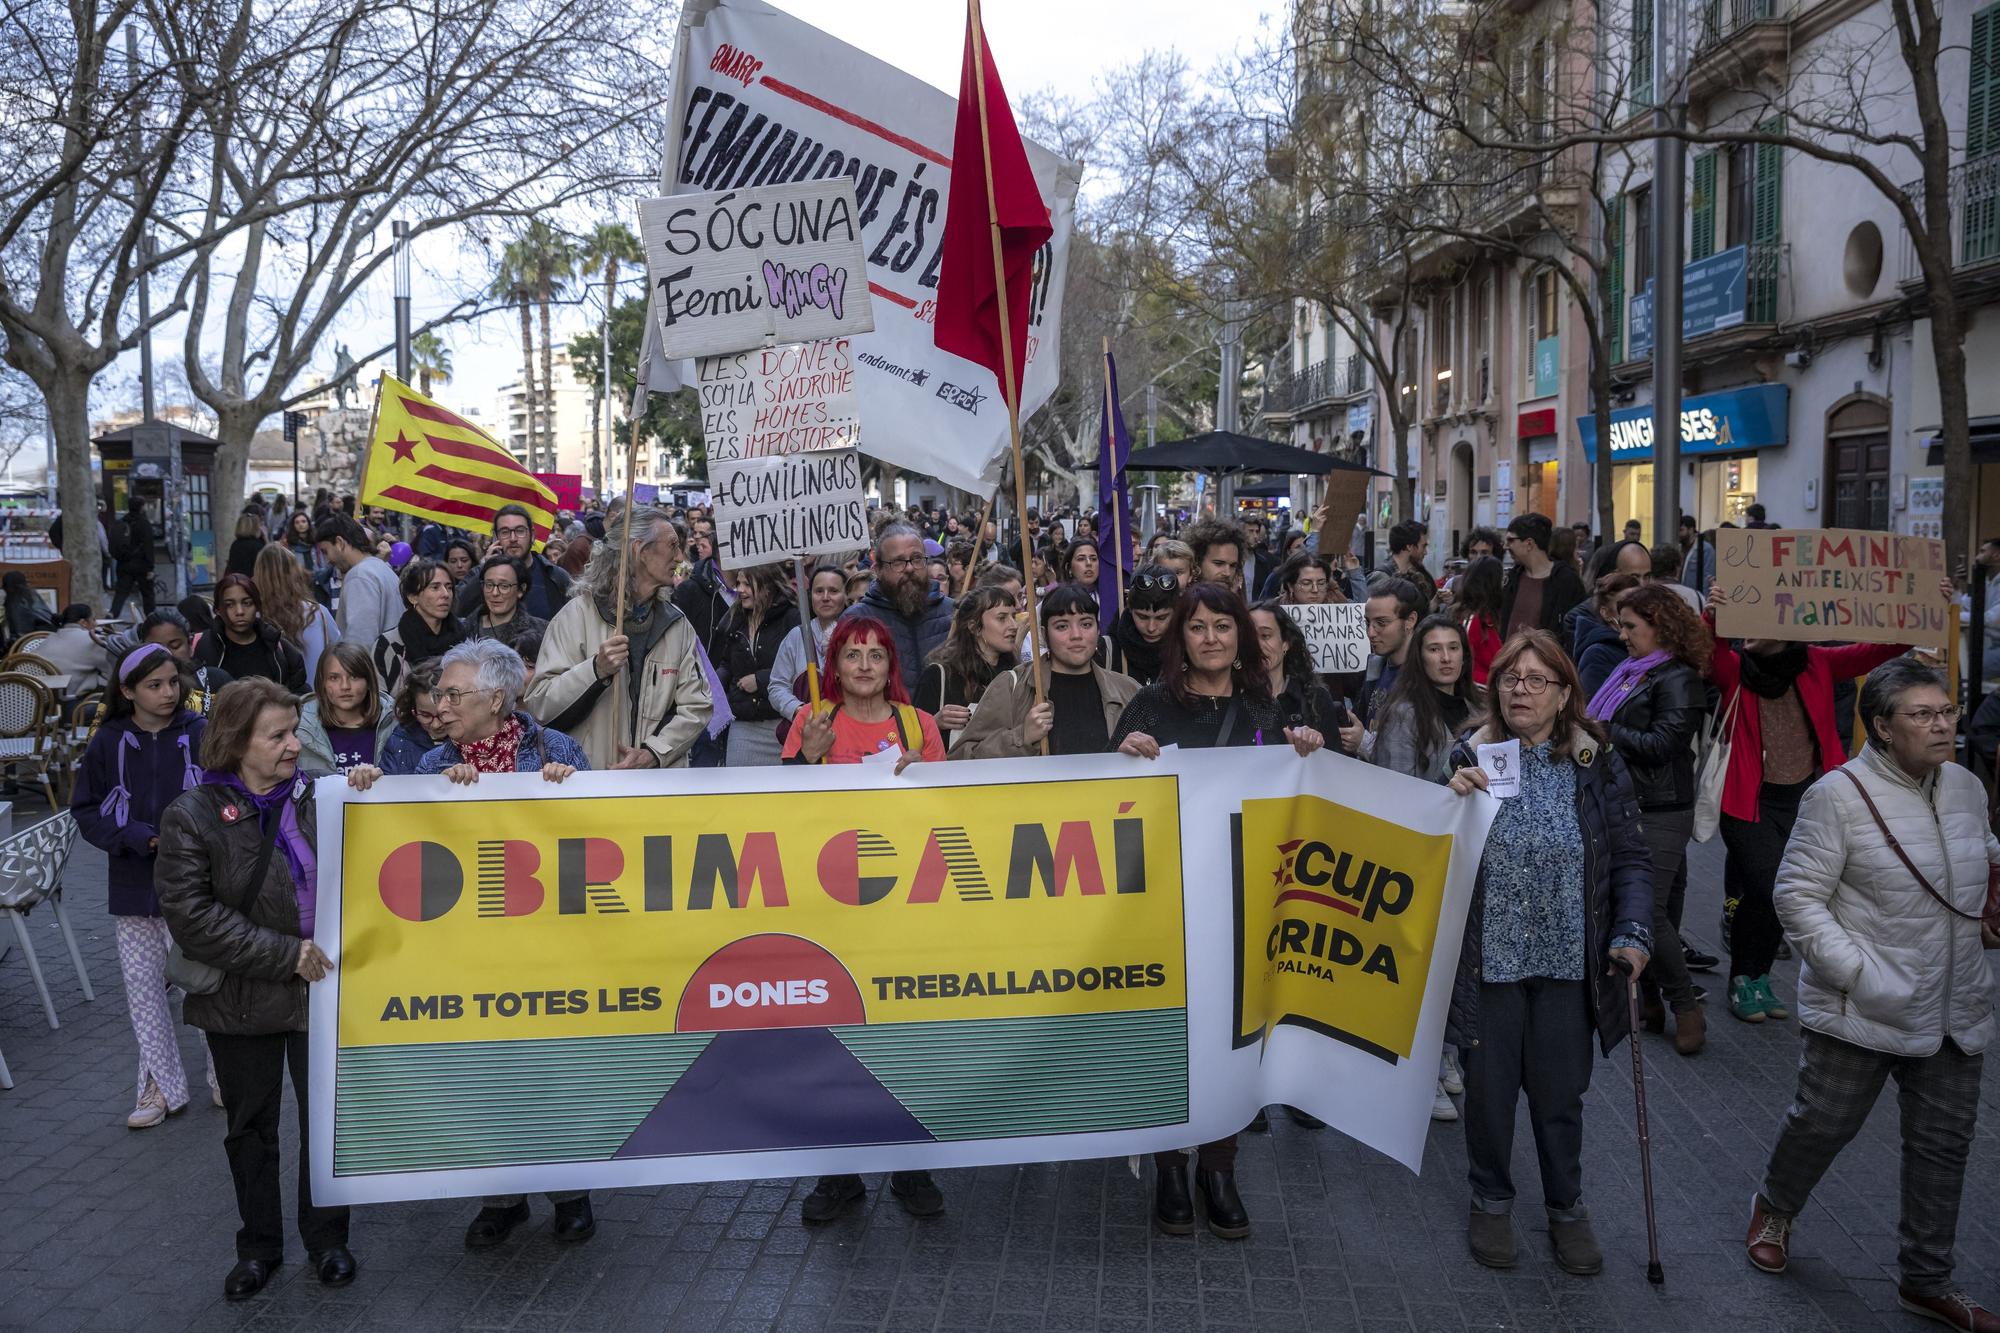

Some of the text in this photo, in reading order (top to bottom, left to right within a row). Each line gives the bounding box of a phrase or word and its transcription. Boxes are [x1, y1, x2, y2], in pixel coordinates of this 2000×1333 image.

[665, 192, 854, 255] SÓC UNA
[868, 162, 940, 273] ÉS
[700, 340, 849, 382] LES DONES
[857, 352, 912, 380] endavant
[701, 370, 854, 409] SOM LA SÍNDROME
[704, 410, 738, 435] ELS
[1609, 407, 1716, 451] SUNGSES
[706, 436, 739, 461] ELS
[1303, 624, 1365, 640] RMANAS
[1307, 605, 1332, 624] SIN
[1335, 604, 1363, 624] MIS
[1306, 642, 1360, 671] RANS
[378, 801, 1146, 922] OBRIM CAMÍ
[1266, 917, 1400, 985] CRIDA
[1276, 960, 1335, 983] PALMA
[379, 962, 1166, 1021] AMB TOTES LES DONES TREBALLADORES
